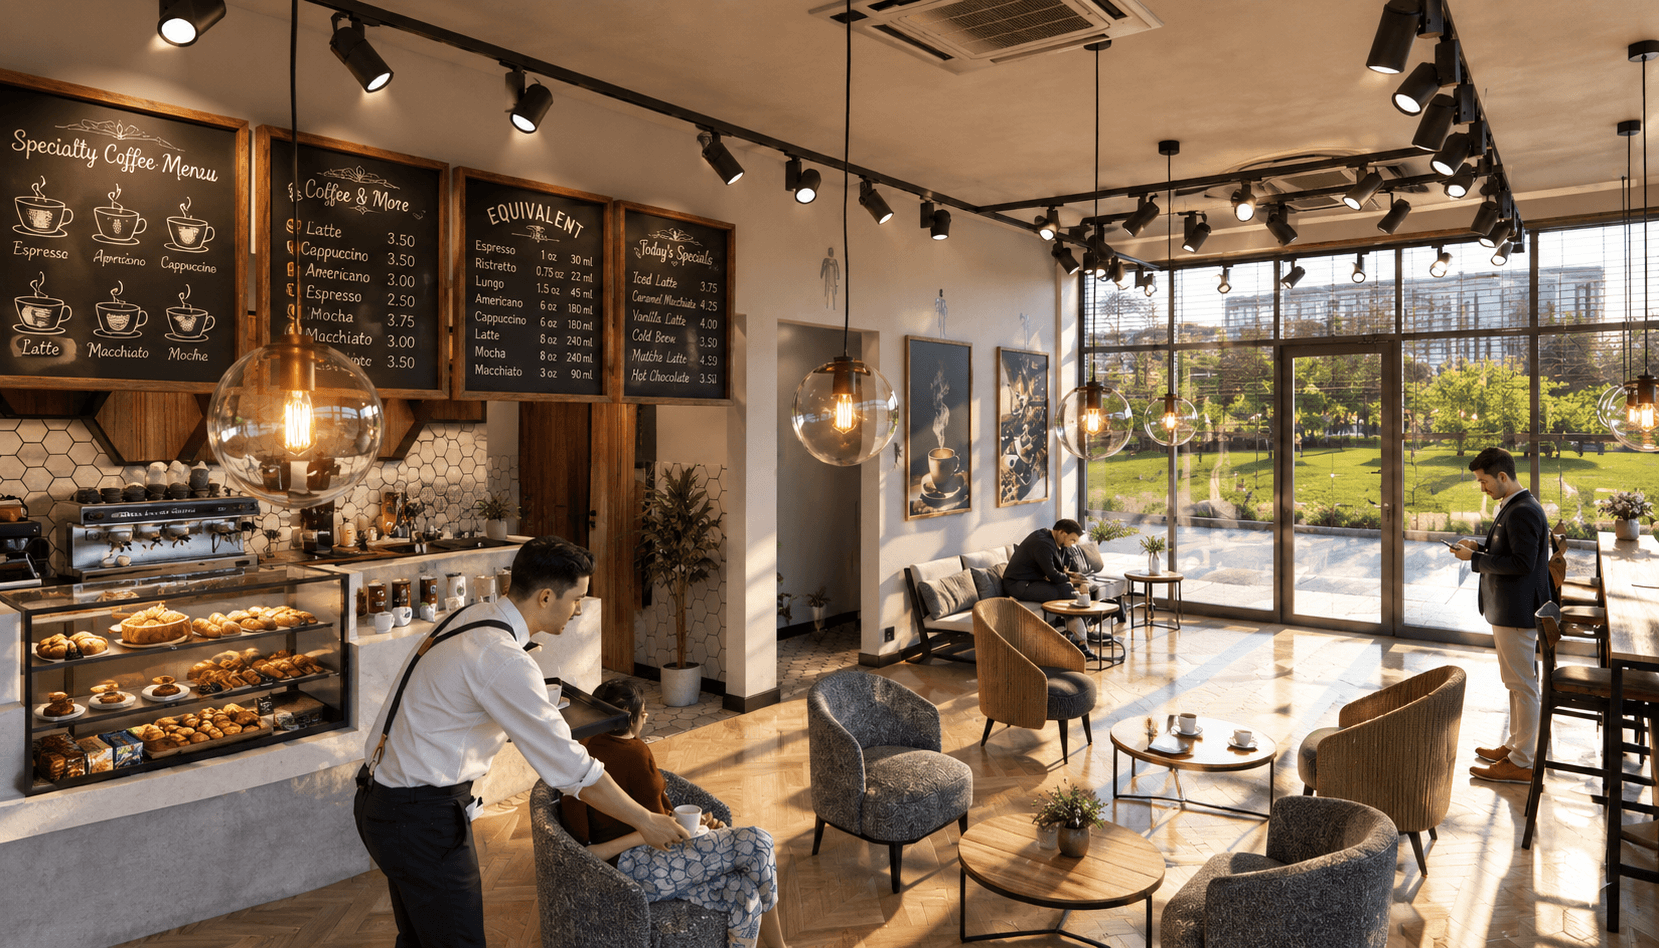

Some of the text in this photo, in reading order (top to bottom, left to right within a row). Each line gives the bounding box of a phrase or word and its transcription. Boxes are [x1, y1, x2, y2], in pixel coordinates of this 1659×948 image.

[305, 179, 409, 212] Coffee & More
[487, 202, 584, 239] EQUIVALENT
[306, 221, 415, 248] Latte 3.50
[387, 252, 415, 267] 3.50
[475, 240, 515, 255] Espresso
[541, 250, 545, 260] 1
[548, 253, 557, 261] oz
[571, 254, 581, 265] 30
[639, 239, 713, 266] Today's Specials
[475, 258, 516, 272] Ristretto
[536, 266, 553, 277] 0.75
[555, 271, 564, 279] oz
[571, 271, 580, 281] 22
[387, 273, 415, 287] 3.00
[475, 275, 504, 291] Lungo
[537, 283, 549, 294] 1.5
[551, 287, 560, 295] oz
[700, 281, 718, 293] 3.75
[307, 284, 415, 307] Espresso 2.50
[475, 294, 523, 308] Americano
[540, 300, 545, 310] 6
[568, 304, 581, 313] 180
[700, 300, 718, 311] 4.25
[387, 313, 415, 328] 3.75
[475, 311, 526, 326] Cappuccino
[540, 317, 545, 327] 6
[548, 320, 557, 328] oz
[568, 320, 581, 329] 180
[700, 318, 718, 329] 4.00
[306, 328, 415, 348] Macchiato 3.00
[475, 328, 500, 340] Latte
[547, 337, 557, 345] oz
[632, 328, 652, 341] Cold
[22, 339, 60, 356] Latte
[86, 342, 149, 359] Macchiato
[475, 346, 506, 358] Mocha
[547, 353, 557, 361] oz
[387, 355, 415, 369] 3.50
[475, 364, 522, 376] Macchiato
[540, 368, 545, 378] 3
[547, 370, 557, 378] oz
[571, 369, 581, 379] 90
